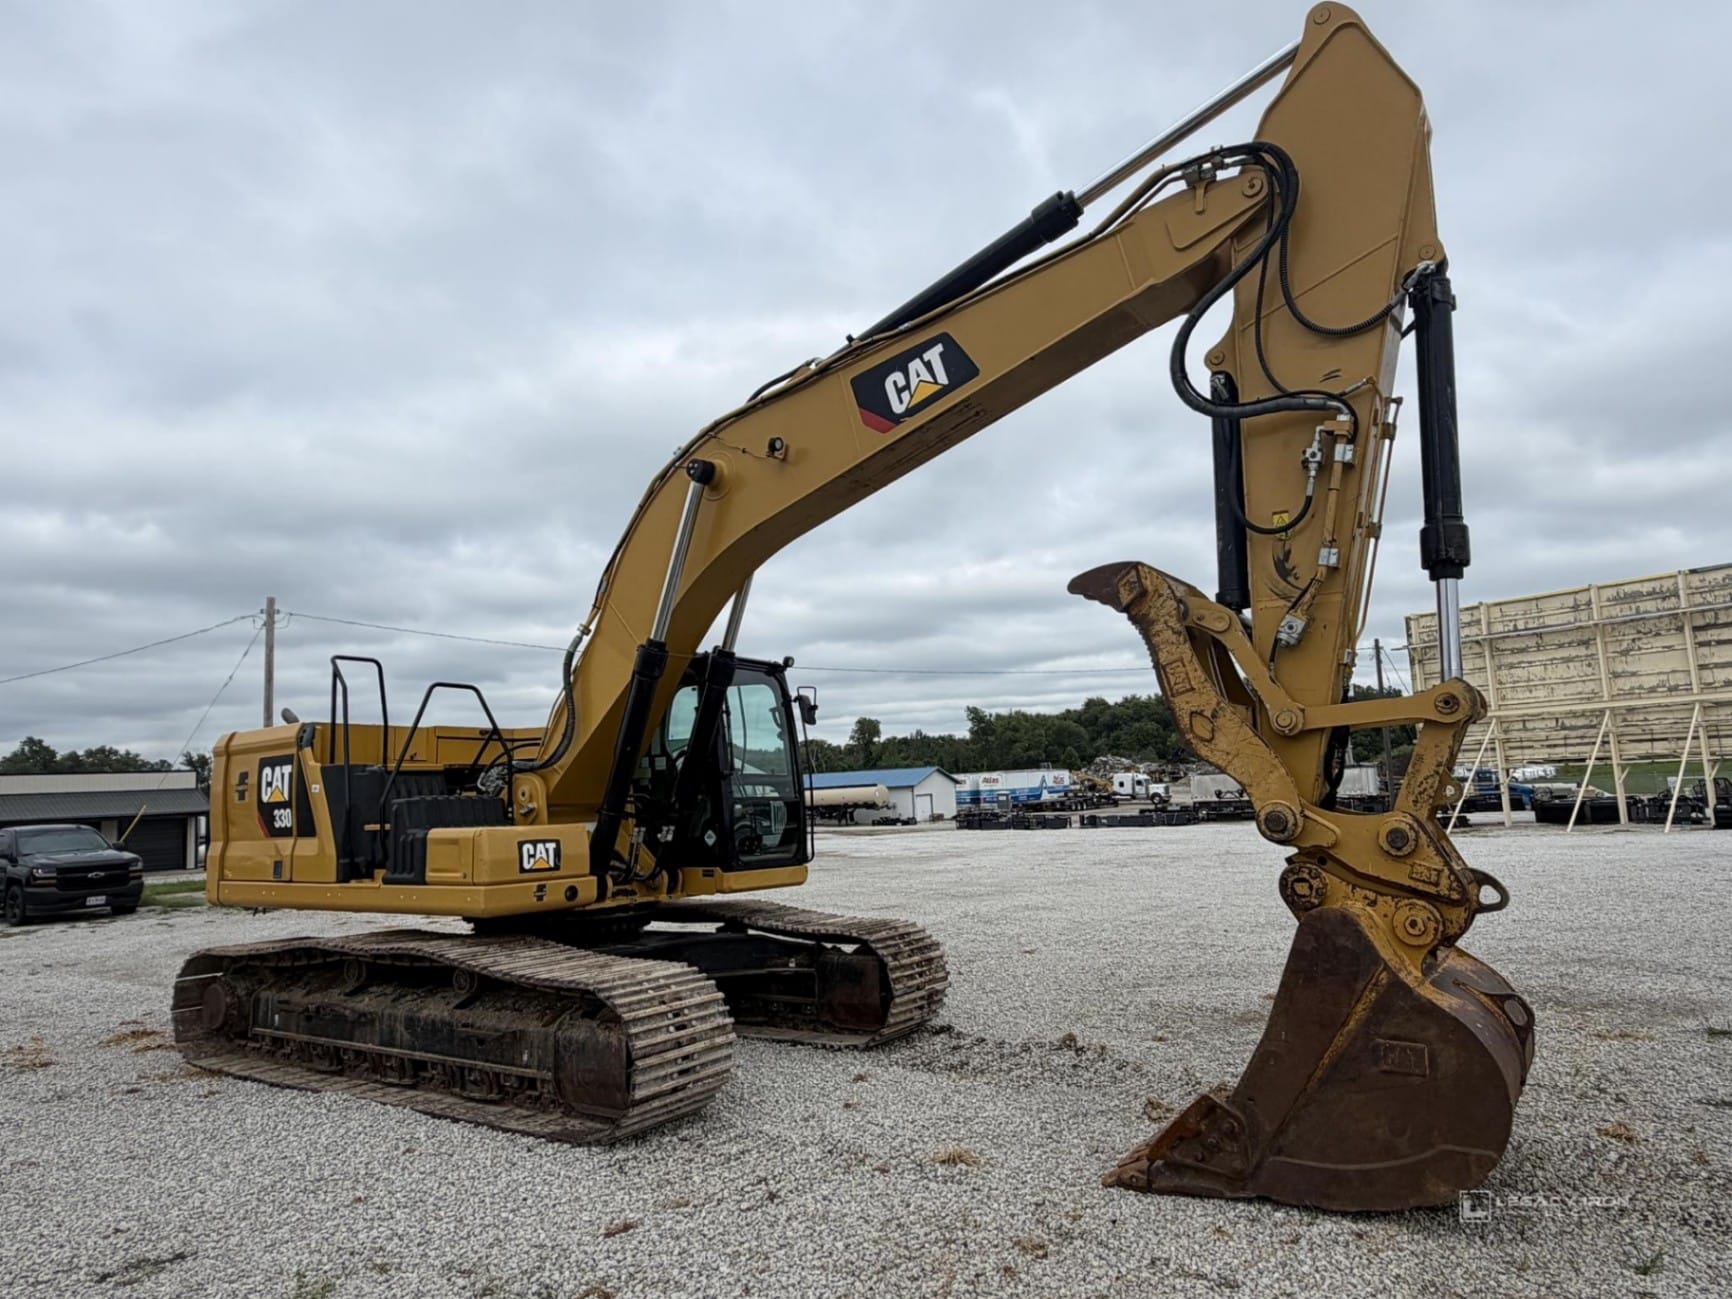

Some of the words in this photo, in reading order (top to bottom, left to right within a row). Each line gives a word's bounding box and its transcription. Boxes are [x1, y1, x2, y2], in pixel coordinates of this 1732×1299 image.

[884, 342, 949, 414] CAT
[261, 764, 293, 803] CAT
[273, 808, 293, 829] 330
[522, 842, 557, 870] CAT
